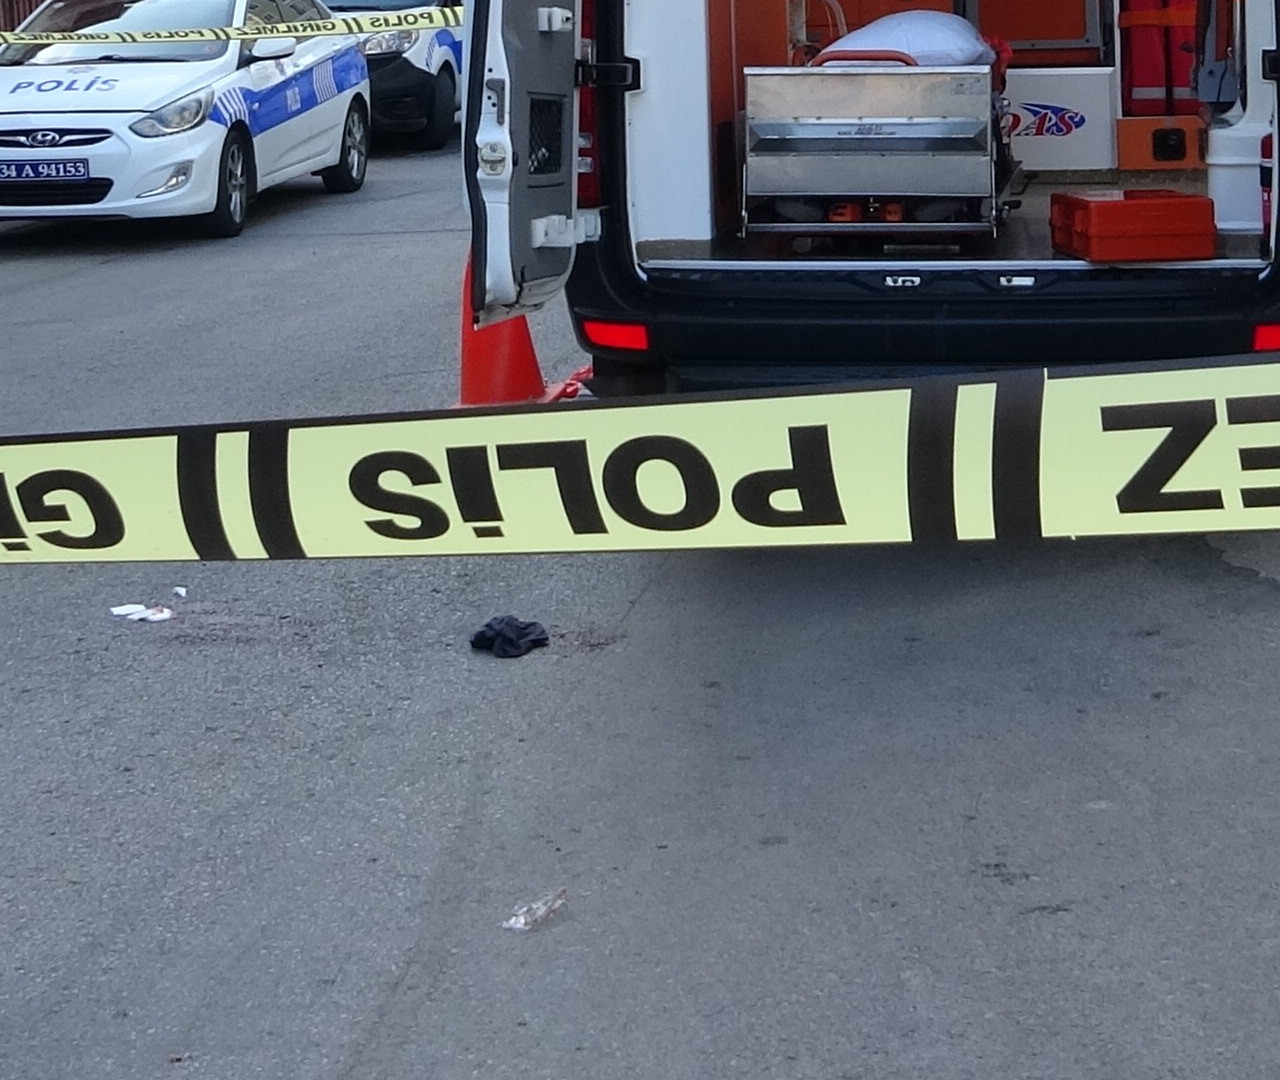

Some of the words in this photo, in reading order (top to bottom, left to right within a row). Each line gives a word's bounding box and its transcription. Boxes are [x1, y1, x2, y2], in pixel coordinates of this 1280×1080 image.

[9, 76, 120, 94] POLİS
[0, 165, 17, 177] 34
[22, 165, 35, 177] A
[38, 163, 86, 176] 94153
[347, 423, 847, 540] POLİS
